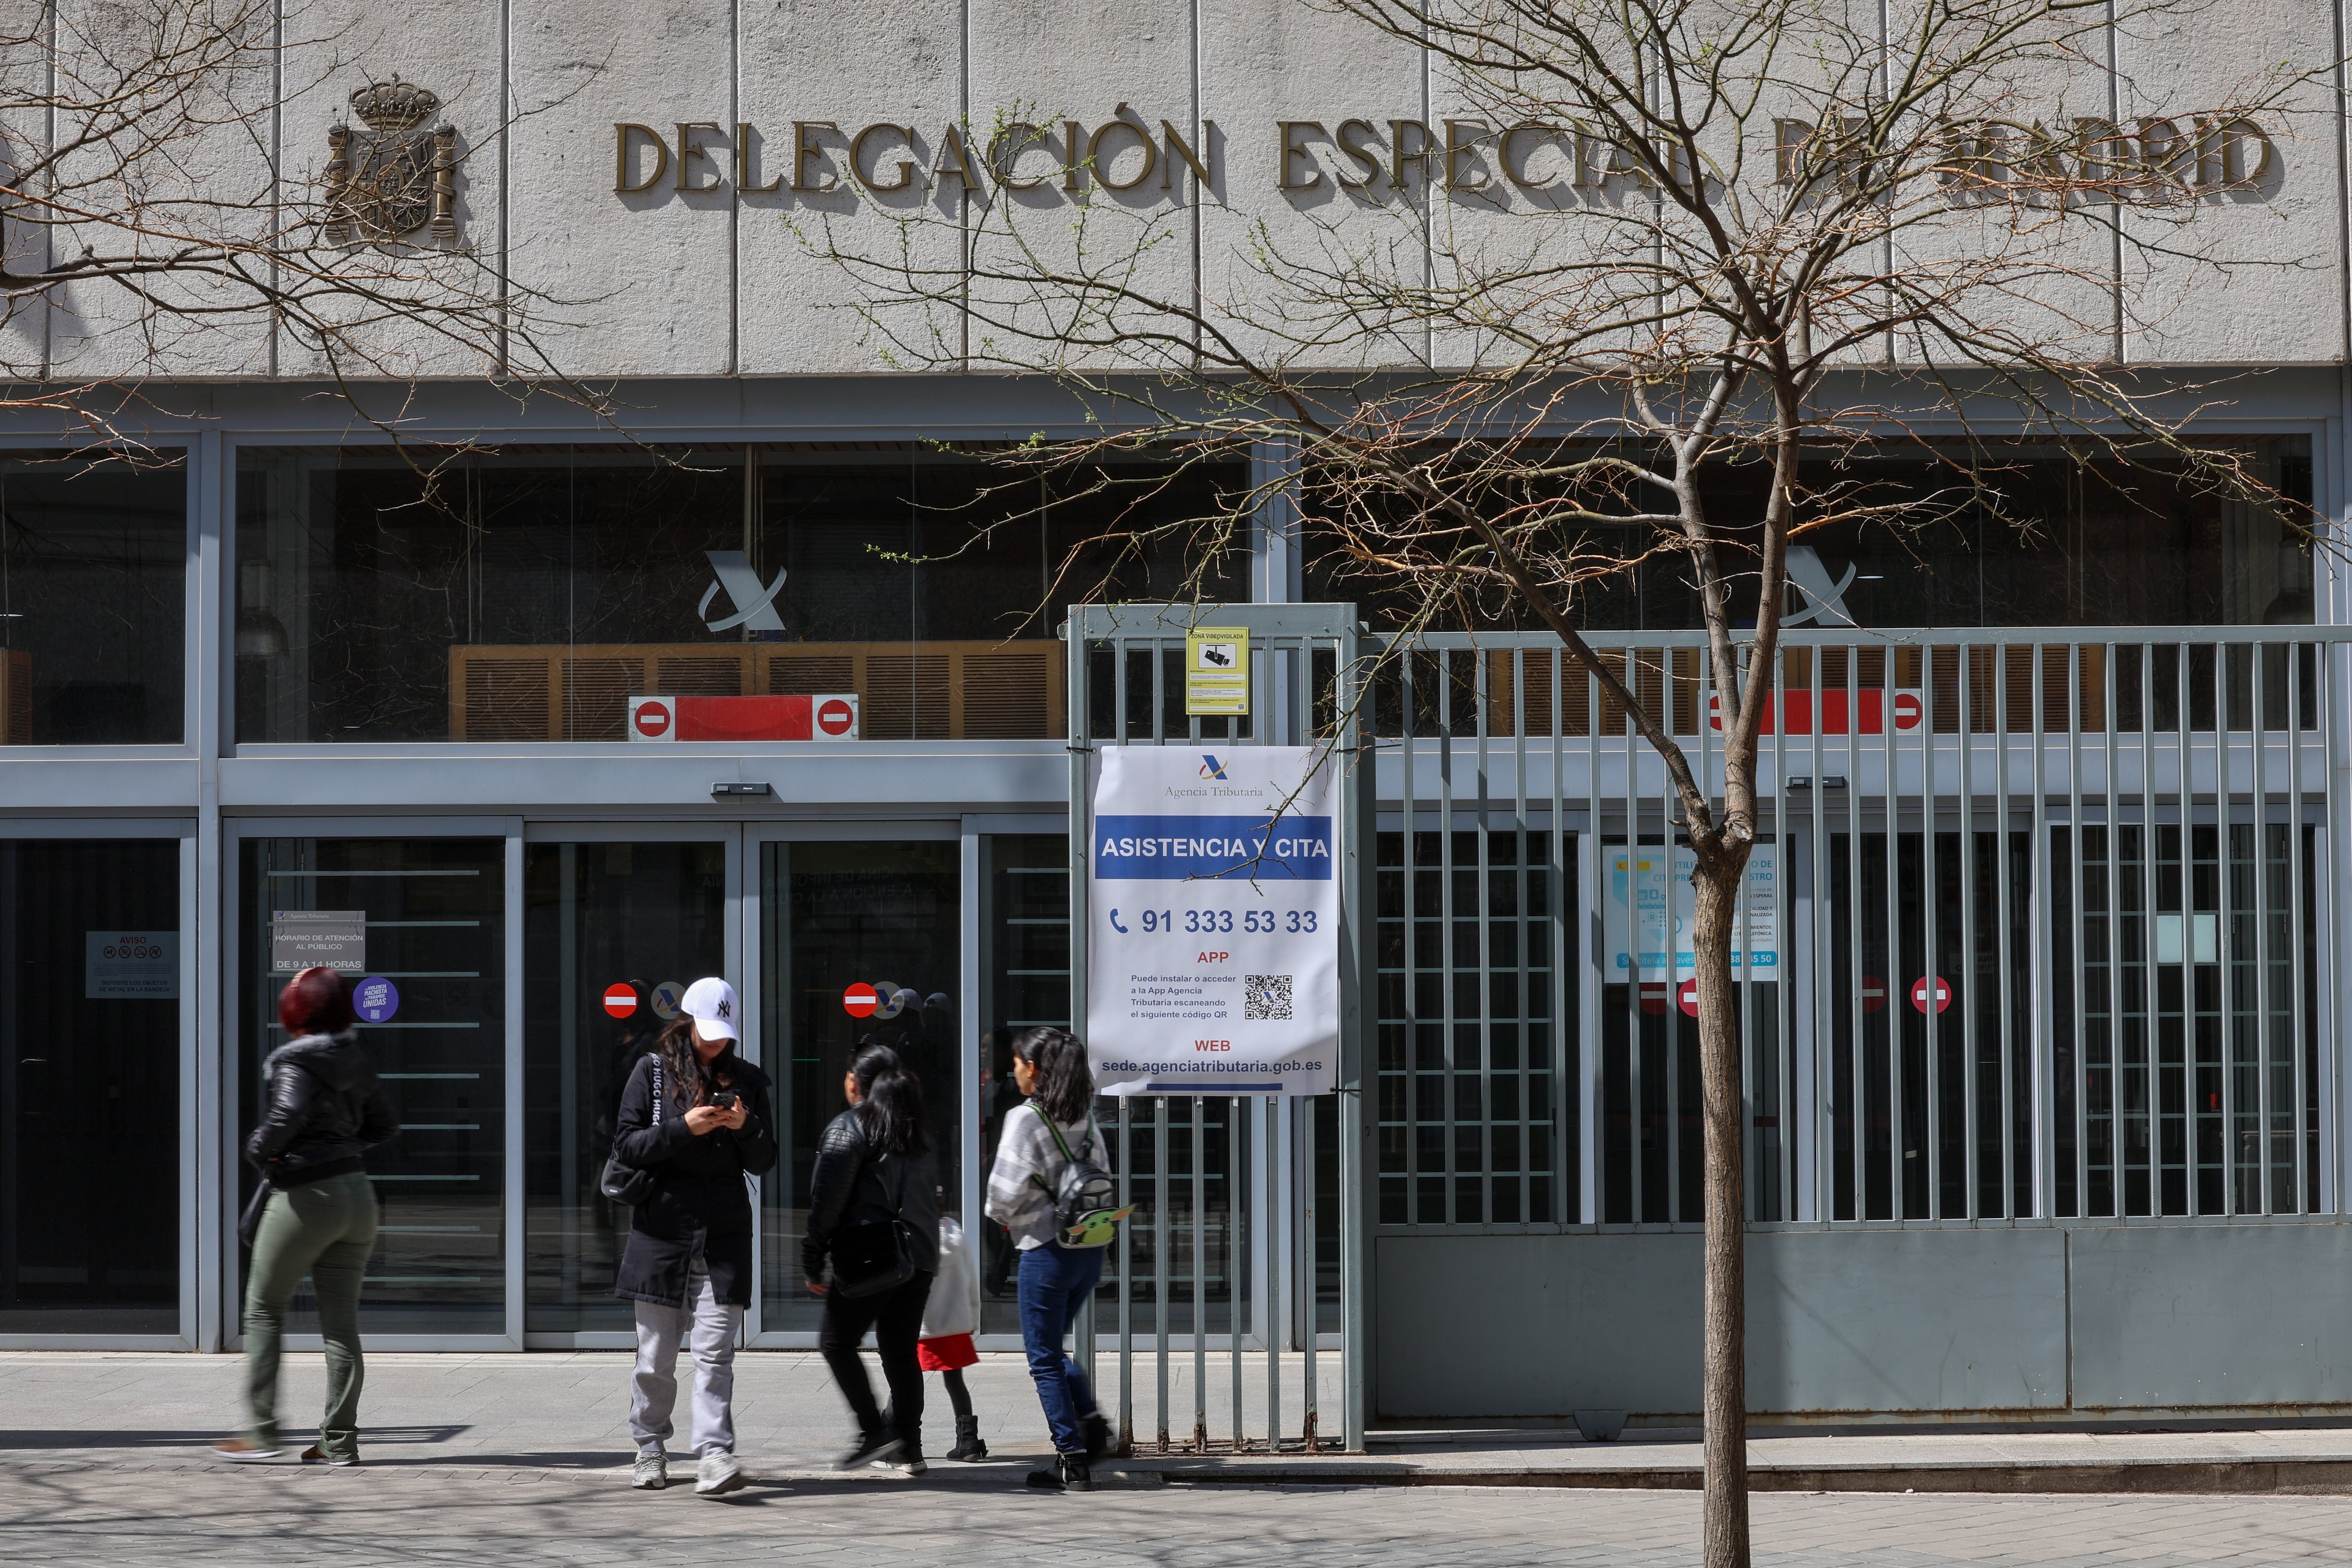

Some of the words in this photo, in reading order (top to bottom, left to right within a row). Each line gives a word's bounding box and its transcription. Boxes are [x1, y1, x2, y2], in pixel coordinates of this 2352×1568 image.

[612, 101, 1214, 191] DELEGACIÓN
[1164, 786, 1208, 799] Agencia
[1211, 786, 1263, 796] Tributaria
[1101, 838, 1247, 857] ASISTENCIA
[1252, 839, 1269, 857] Y
[1275, 839, 1329, 858] CITA
[1142, 910, 1171, 932] 91
[1184, 910, 1233, 933] 333
[1244, 910, 1275, 933] 53
[1286, 910, 1317, 933] 33
[1197, 952, 1229, 963] APP
[1168, 987, 1202, 995] Agencia
[363, 997, 386, 1008] UNIDAS
[717, 1000, 731, 1018] NY
[1183, 1011, 1211, 1019] código
[1194, 1040, 1231, 1051] WEB
[1102, 1060, 1322, 1075] sede.agenciatributaria.gob.es
[653, 1068, 662, 1098] HUGO
